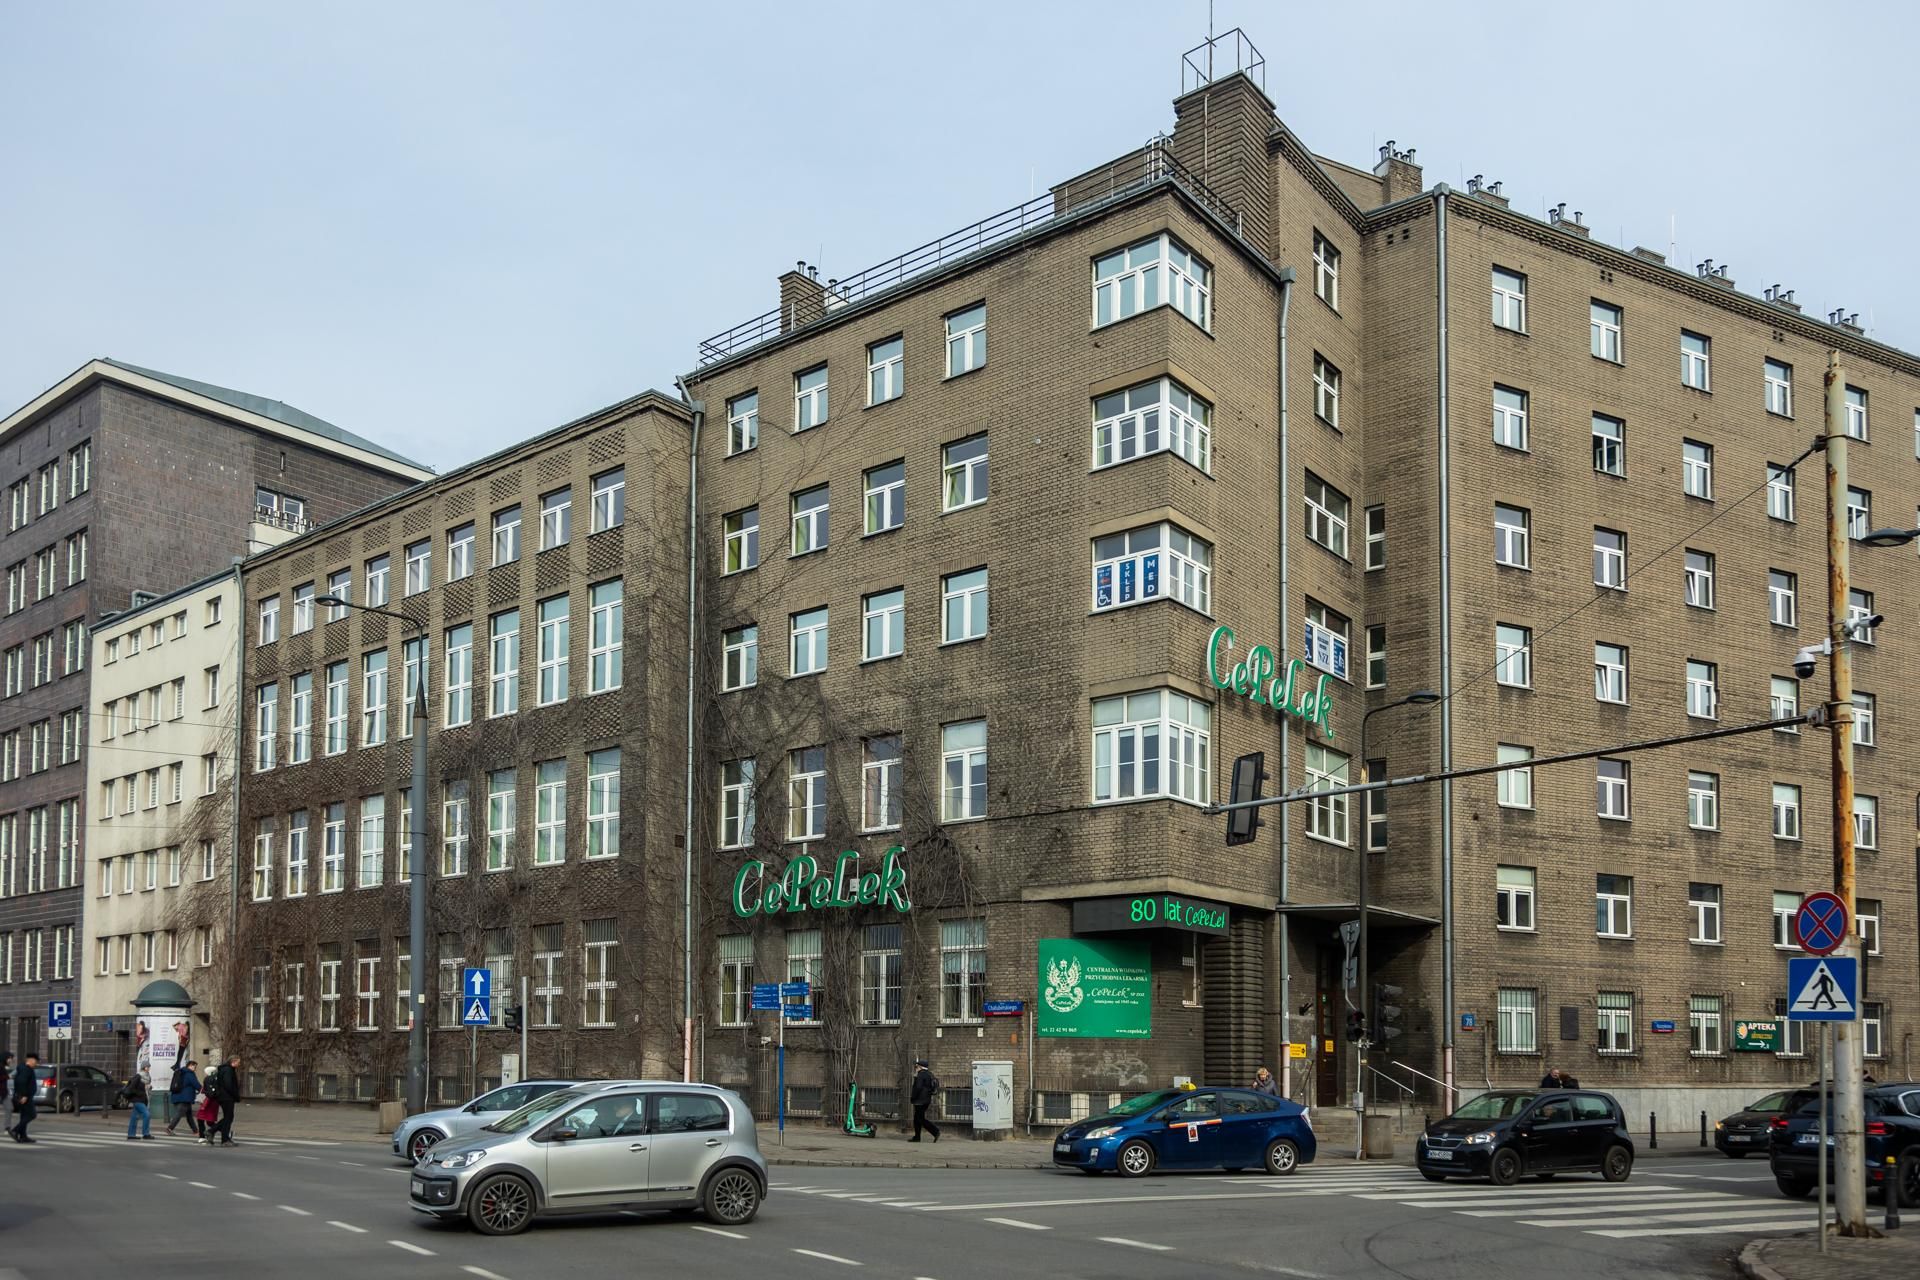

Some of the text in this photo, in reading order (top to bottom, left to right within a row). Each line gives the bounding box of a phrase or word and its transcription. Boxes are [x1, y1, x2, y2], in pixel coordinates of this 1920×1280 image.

[1147, 559, 1156, 593] MED
[1207, 625, 1334, 740] CePeLek
[733, 846, 911, 918] CePeLek
[1130, 898, 1156, 922] 80
[1748, 1022, 1777, 1031] APTEKA
